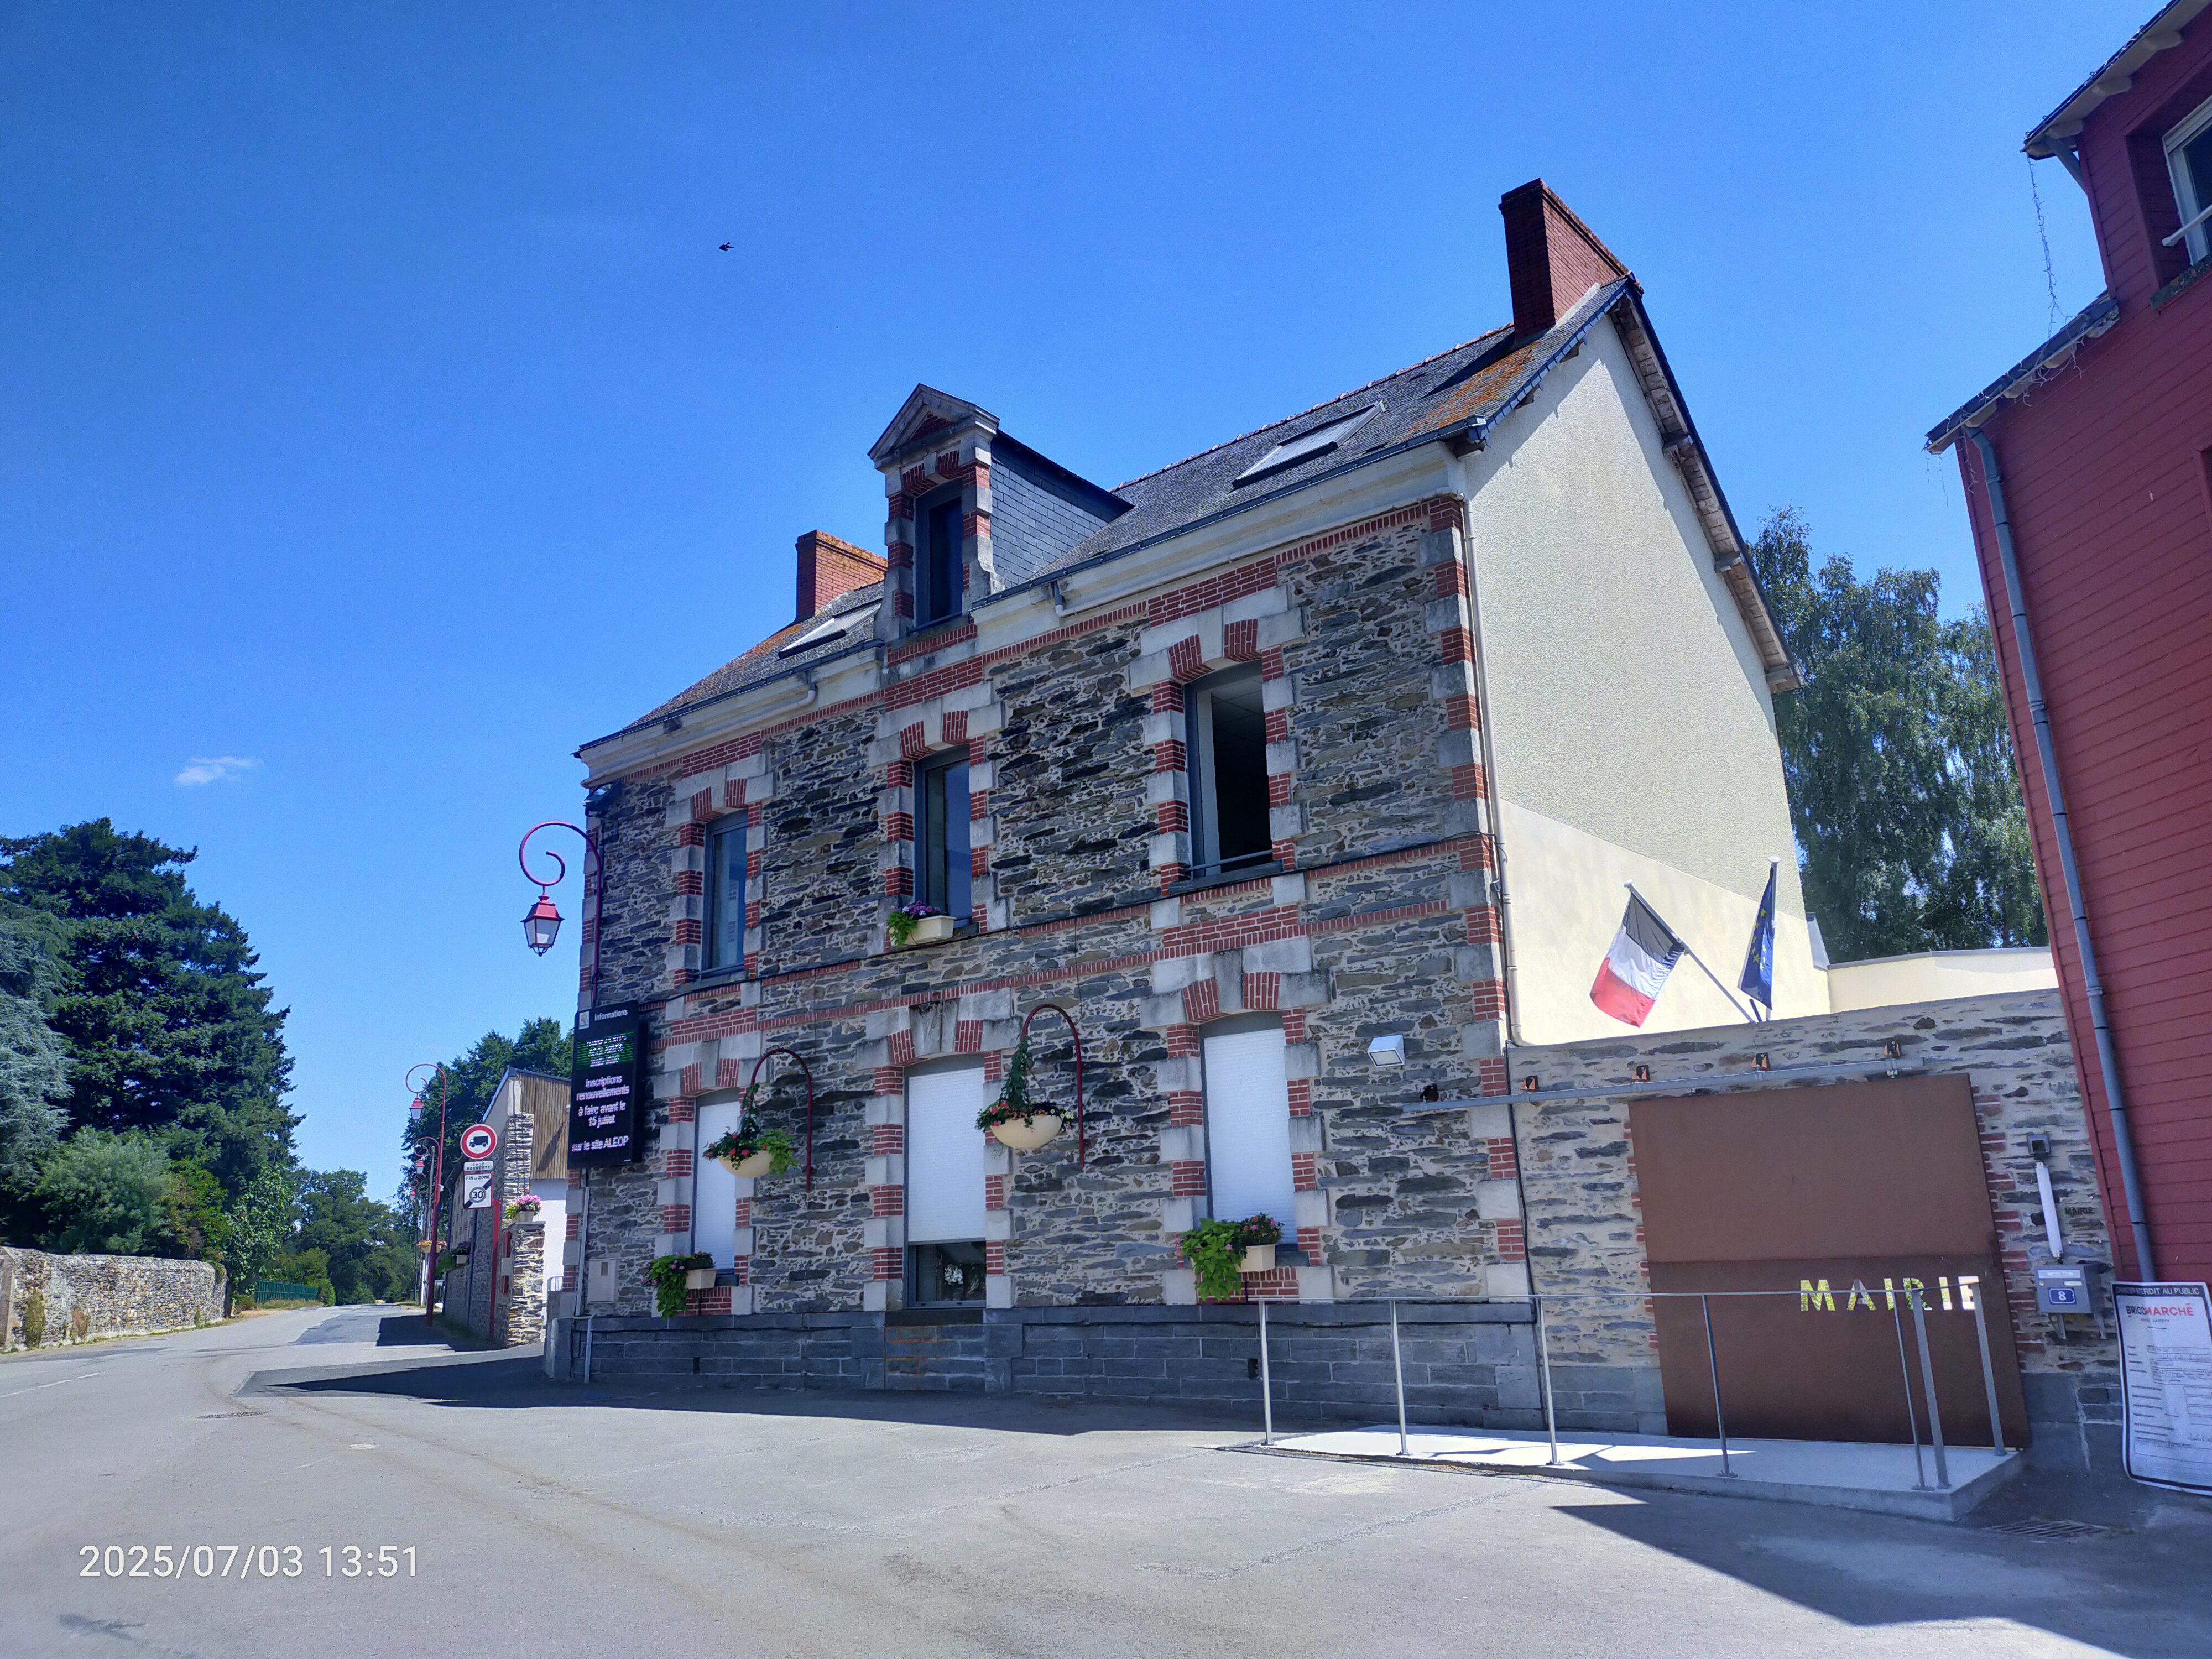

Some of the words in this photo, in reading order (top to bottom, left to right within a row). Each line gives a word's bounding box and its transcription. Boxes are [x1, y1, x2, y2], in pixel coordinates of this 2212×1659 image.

[594, 1009, 628, 1021] Informations
[584, 1105, 599, 1116] faire
[599, 1101, 619, 1114] avant
[619, 1100, 626, 1111] le
[588, 1116, 597, 1126] 15
[597, 1114, 615, 1129] juillet
[571, 1142, 583, 1151] sur
[583, 1140, 590, 1151] le
[472, 1191, 483, 1199] 30
[1800, 1275, 1980, 1311] MAIRIE
[2058, 1291, 2067, 1301] 8
